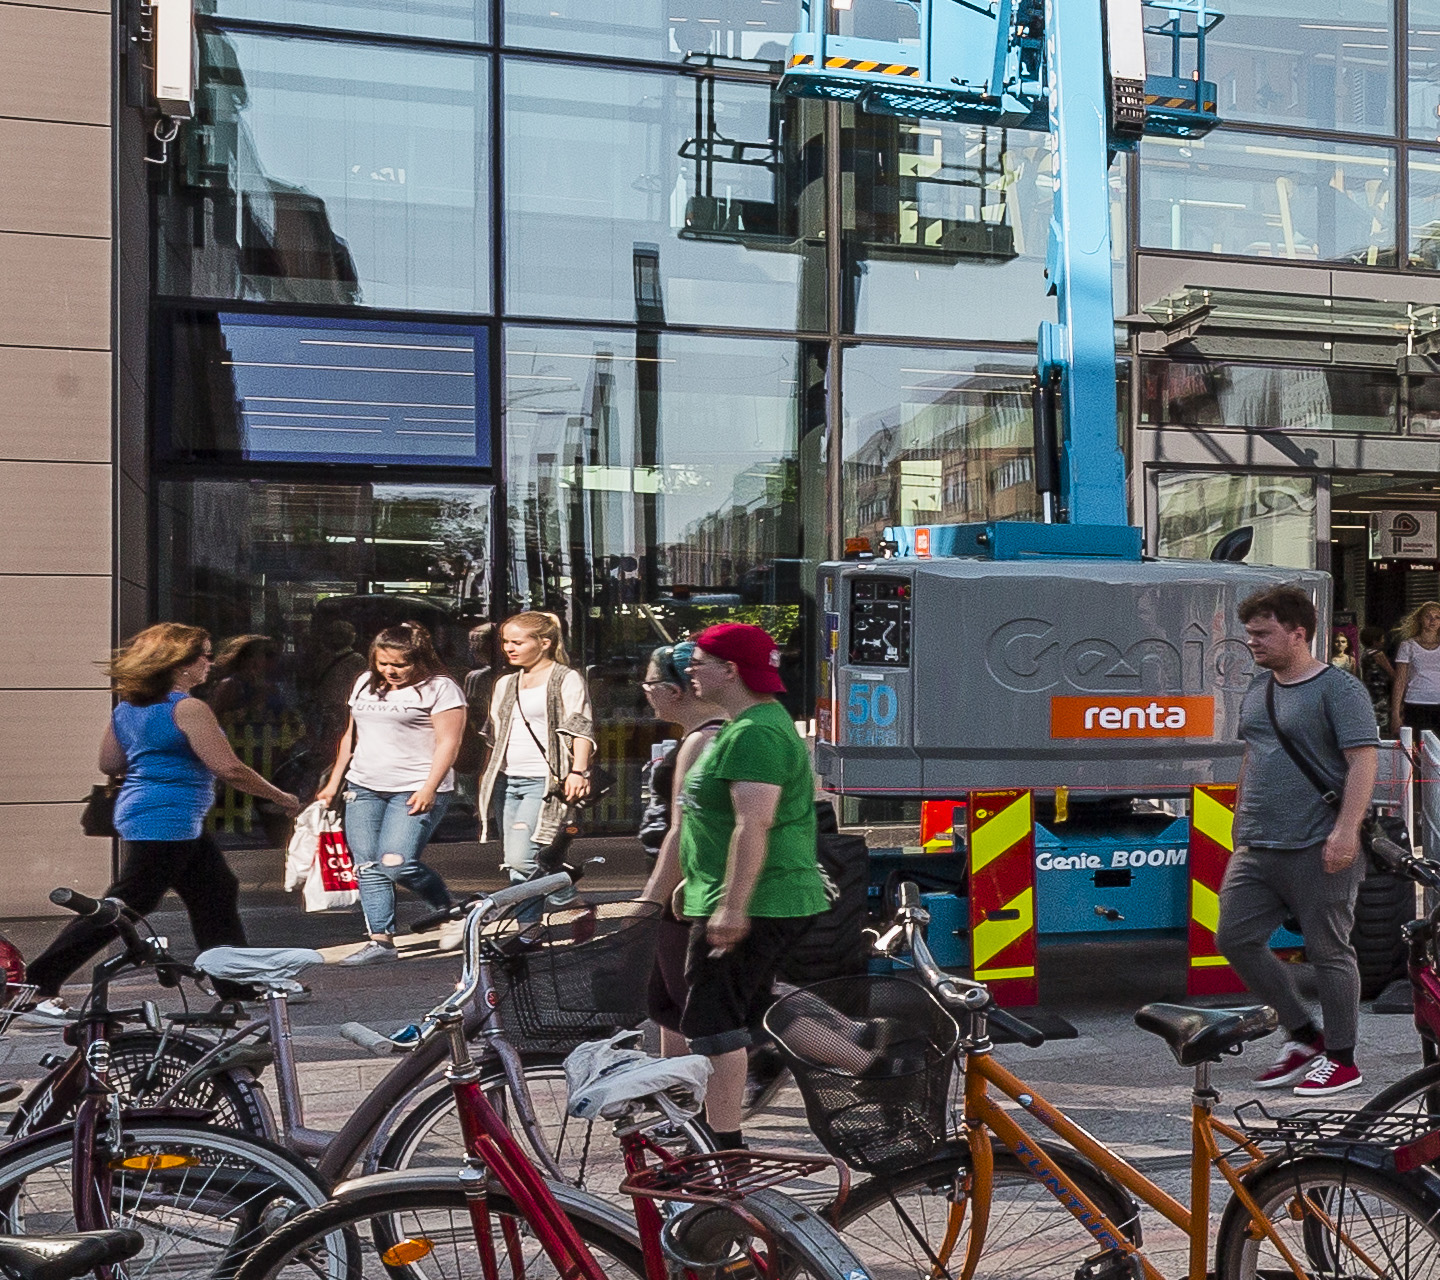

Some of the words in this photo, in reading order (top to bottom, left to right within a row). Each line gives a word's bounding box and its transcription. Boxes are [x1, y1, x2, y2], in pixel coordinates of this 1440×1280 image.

[848, 684, 897, 727] 50
[1084, 702, 1186, 730] renta
[1035, 852, 1103, 870] Genie
[1111, 848, 1188, 868] BOOM
[1016, 1141, 1119, 1249] TUNTUR
